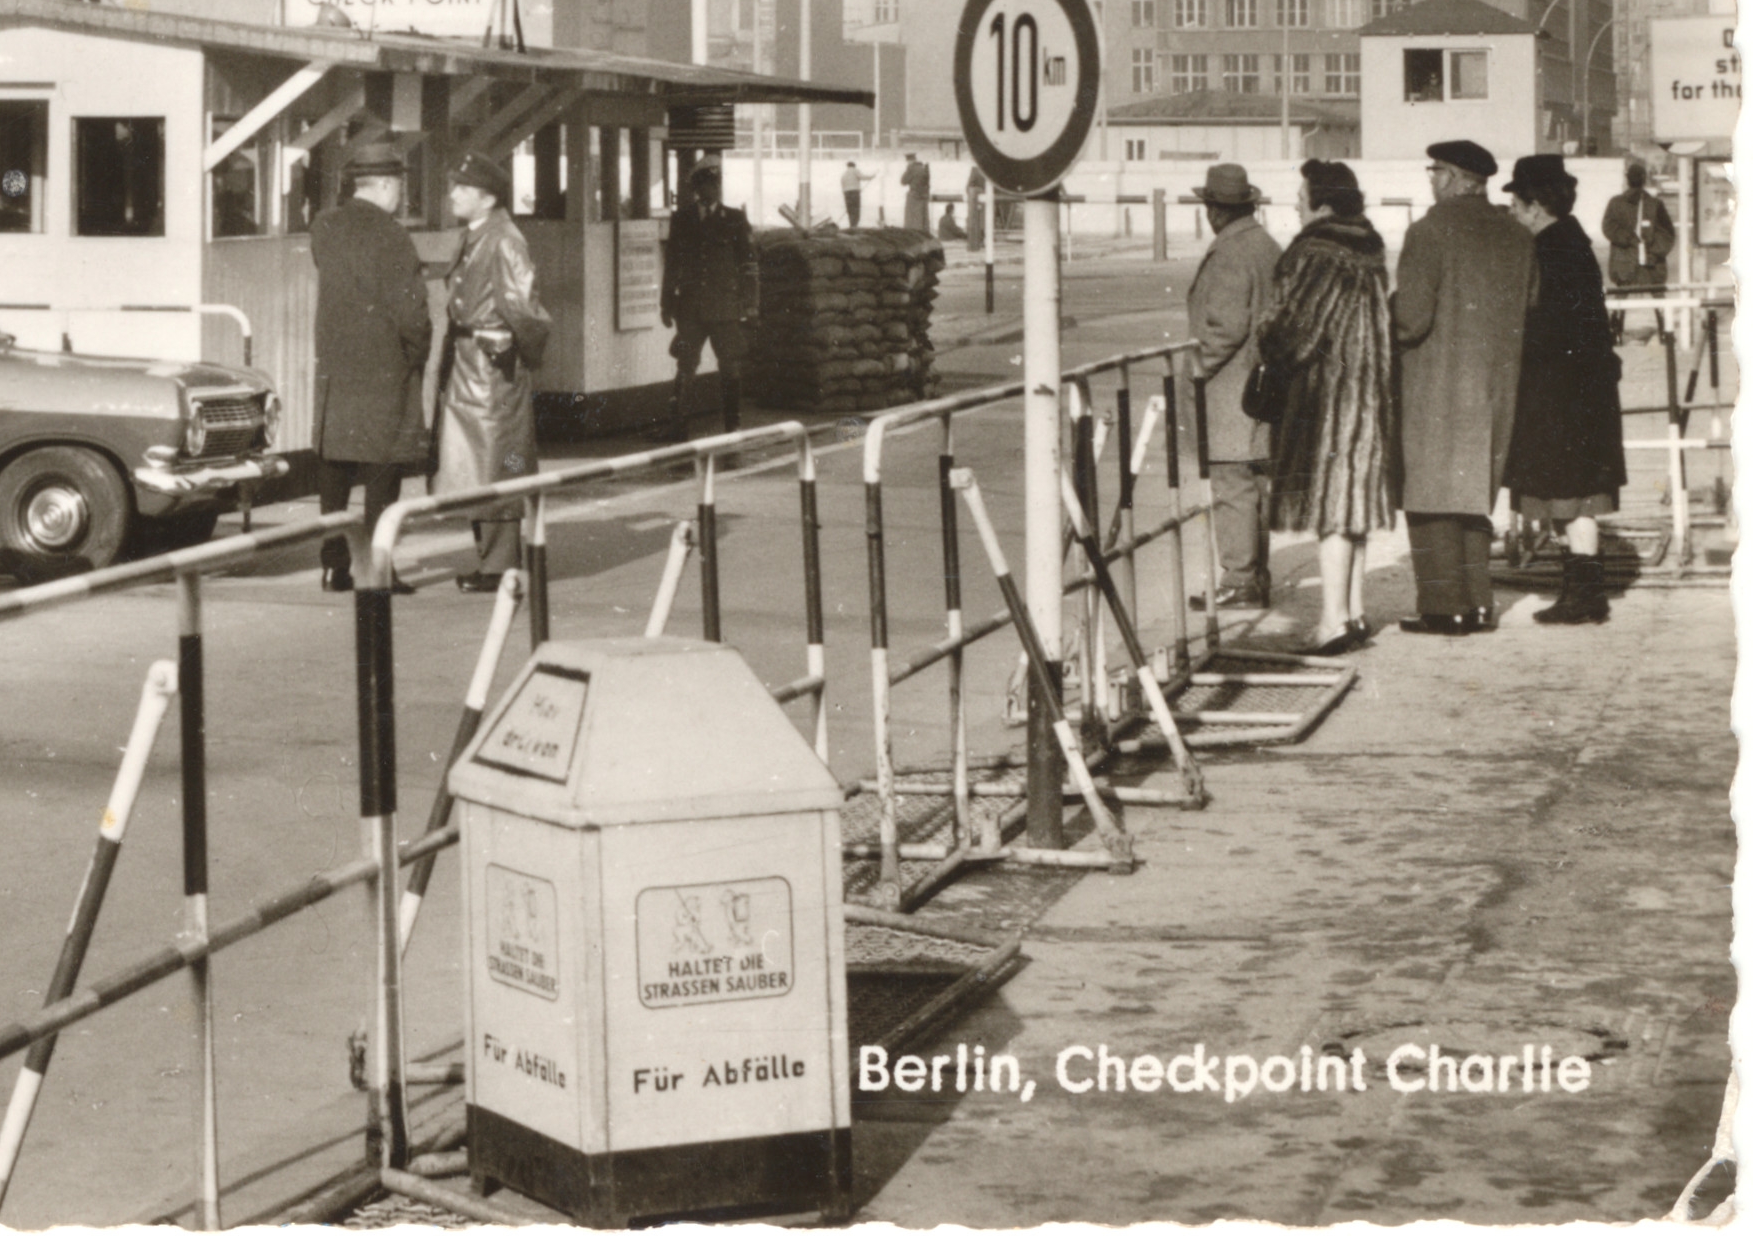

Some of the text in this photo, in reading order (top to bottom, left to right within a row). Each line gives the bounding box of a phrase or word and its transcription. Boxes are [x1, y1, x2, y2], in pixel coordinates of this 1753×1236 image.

[988, 11, 1067, 133] 10 km
[1671, 79, 1704, 101] for
[668, 953, 764, 978] HALTET DIE
[644, 971, 788, 1000] STRASSEN SAUBER
[633, 1053, 805, 1094] Für Abfälle
